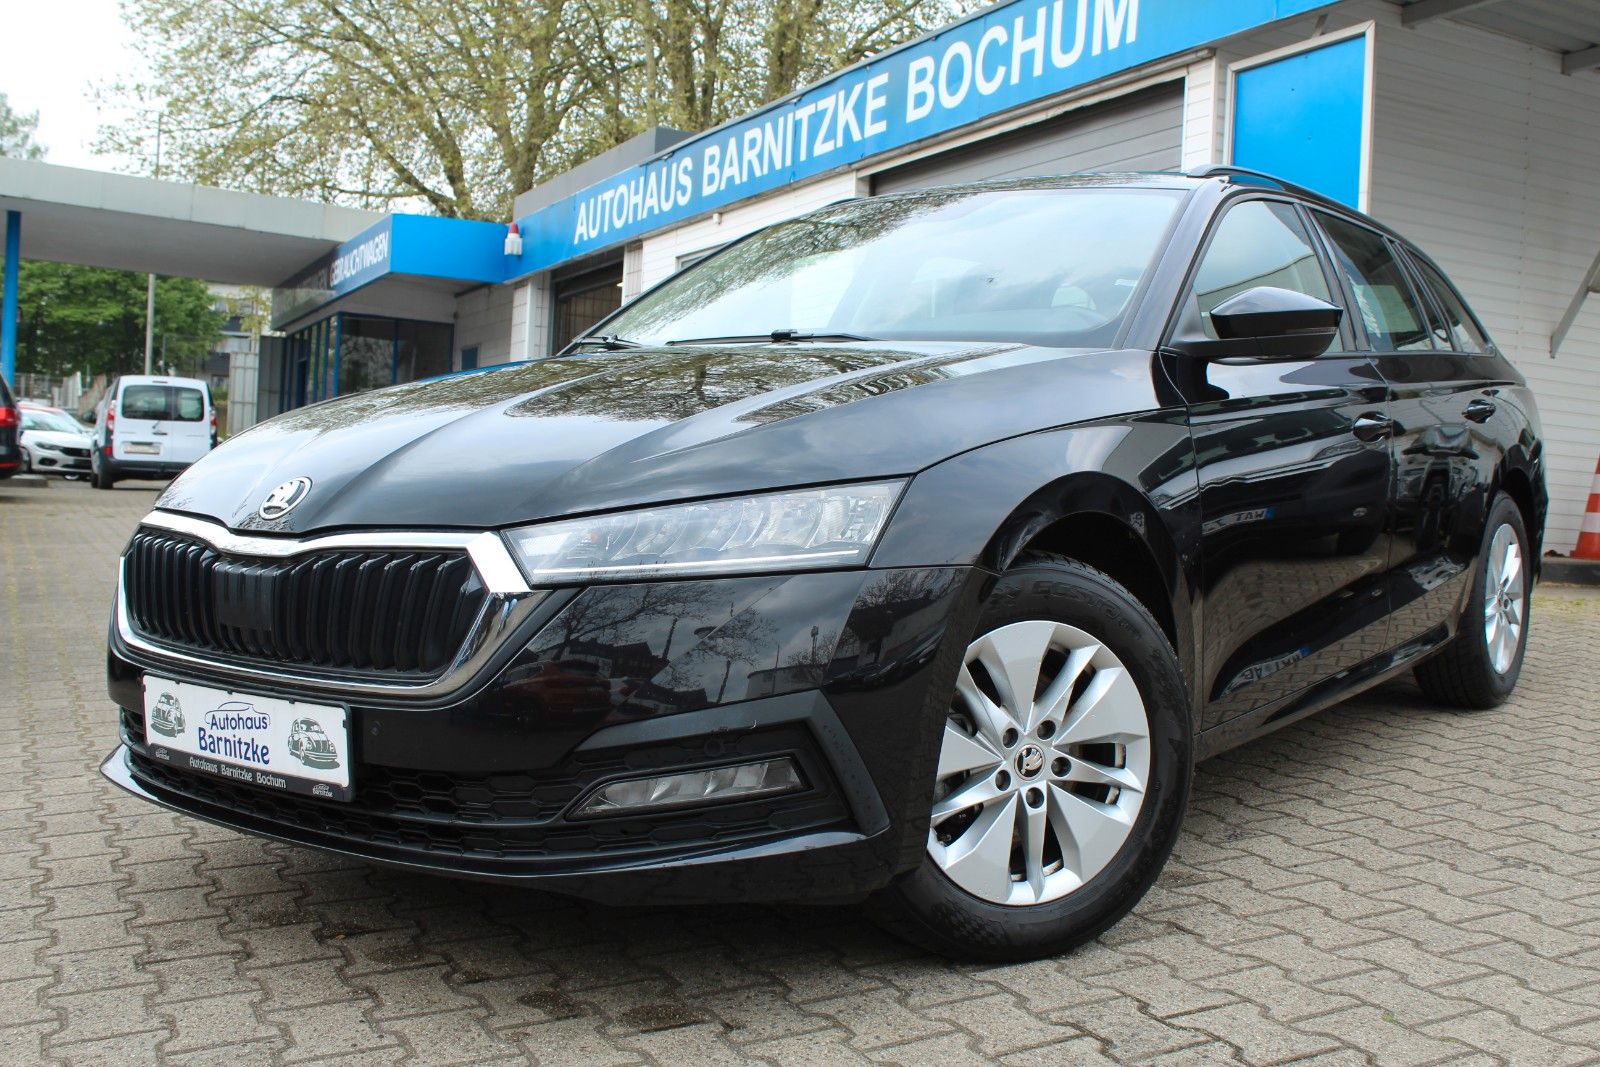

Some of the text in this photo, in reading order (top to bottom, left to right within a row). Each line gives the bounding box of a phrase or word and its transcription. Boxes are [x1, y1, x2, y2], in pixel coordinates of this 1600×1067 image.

[574, 0, 1139, 245] AUTOHAUS BARNITZKE BOCHUM
[210, 713, 268, 731] Autohaus
[198, 726, 270, 765] Barnitzke
[189, 756, 218, 773] Autohaus
[221, 765, 253, 782] Barnitzke
[256, 773, 287, 788] Bochum
